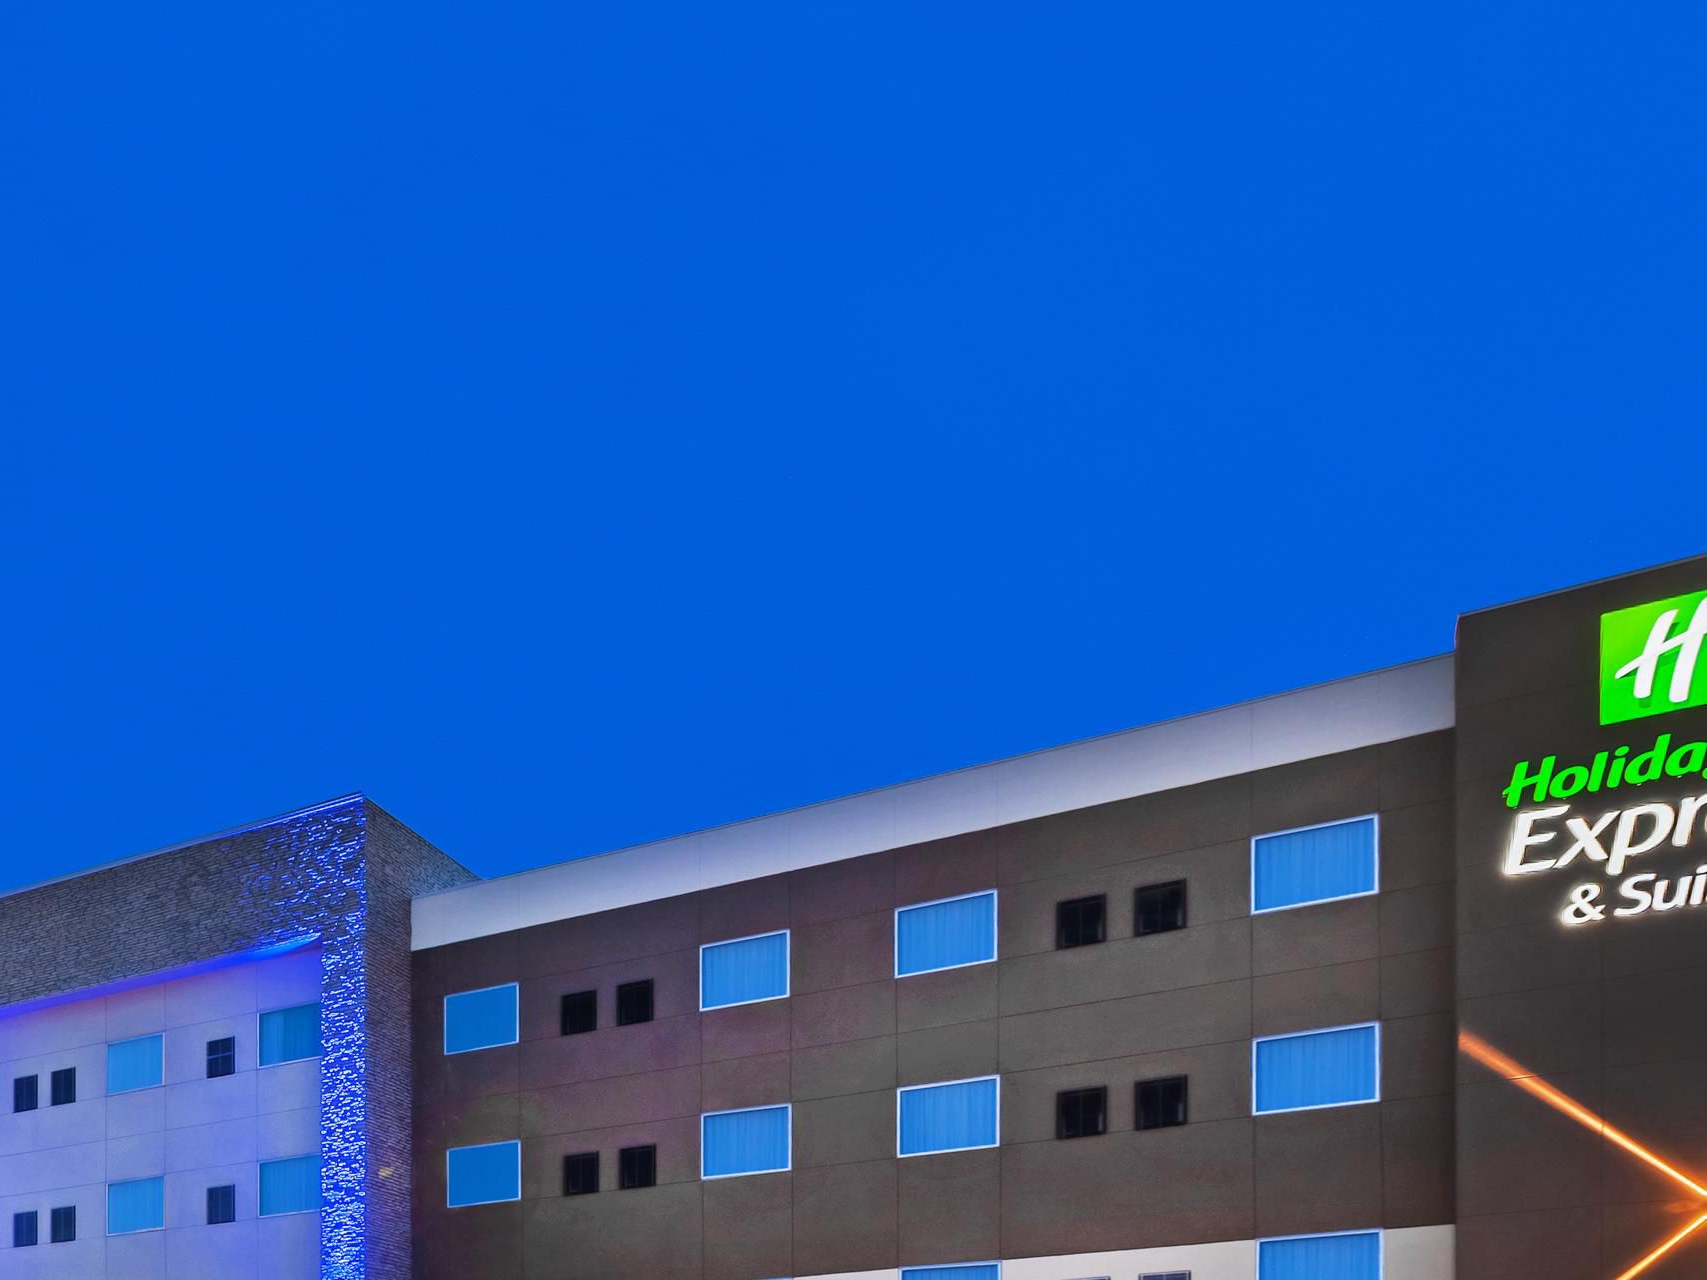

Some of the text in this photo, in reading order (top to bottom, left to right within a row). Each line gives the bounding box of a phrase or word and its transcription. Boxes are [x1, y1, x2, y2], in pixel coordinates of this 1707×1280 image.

[1502, 733, 1707, 808] Holida
[1502, 793, 1707, 876] Expr
[1560, 863, 1707, 925] & Sui
